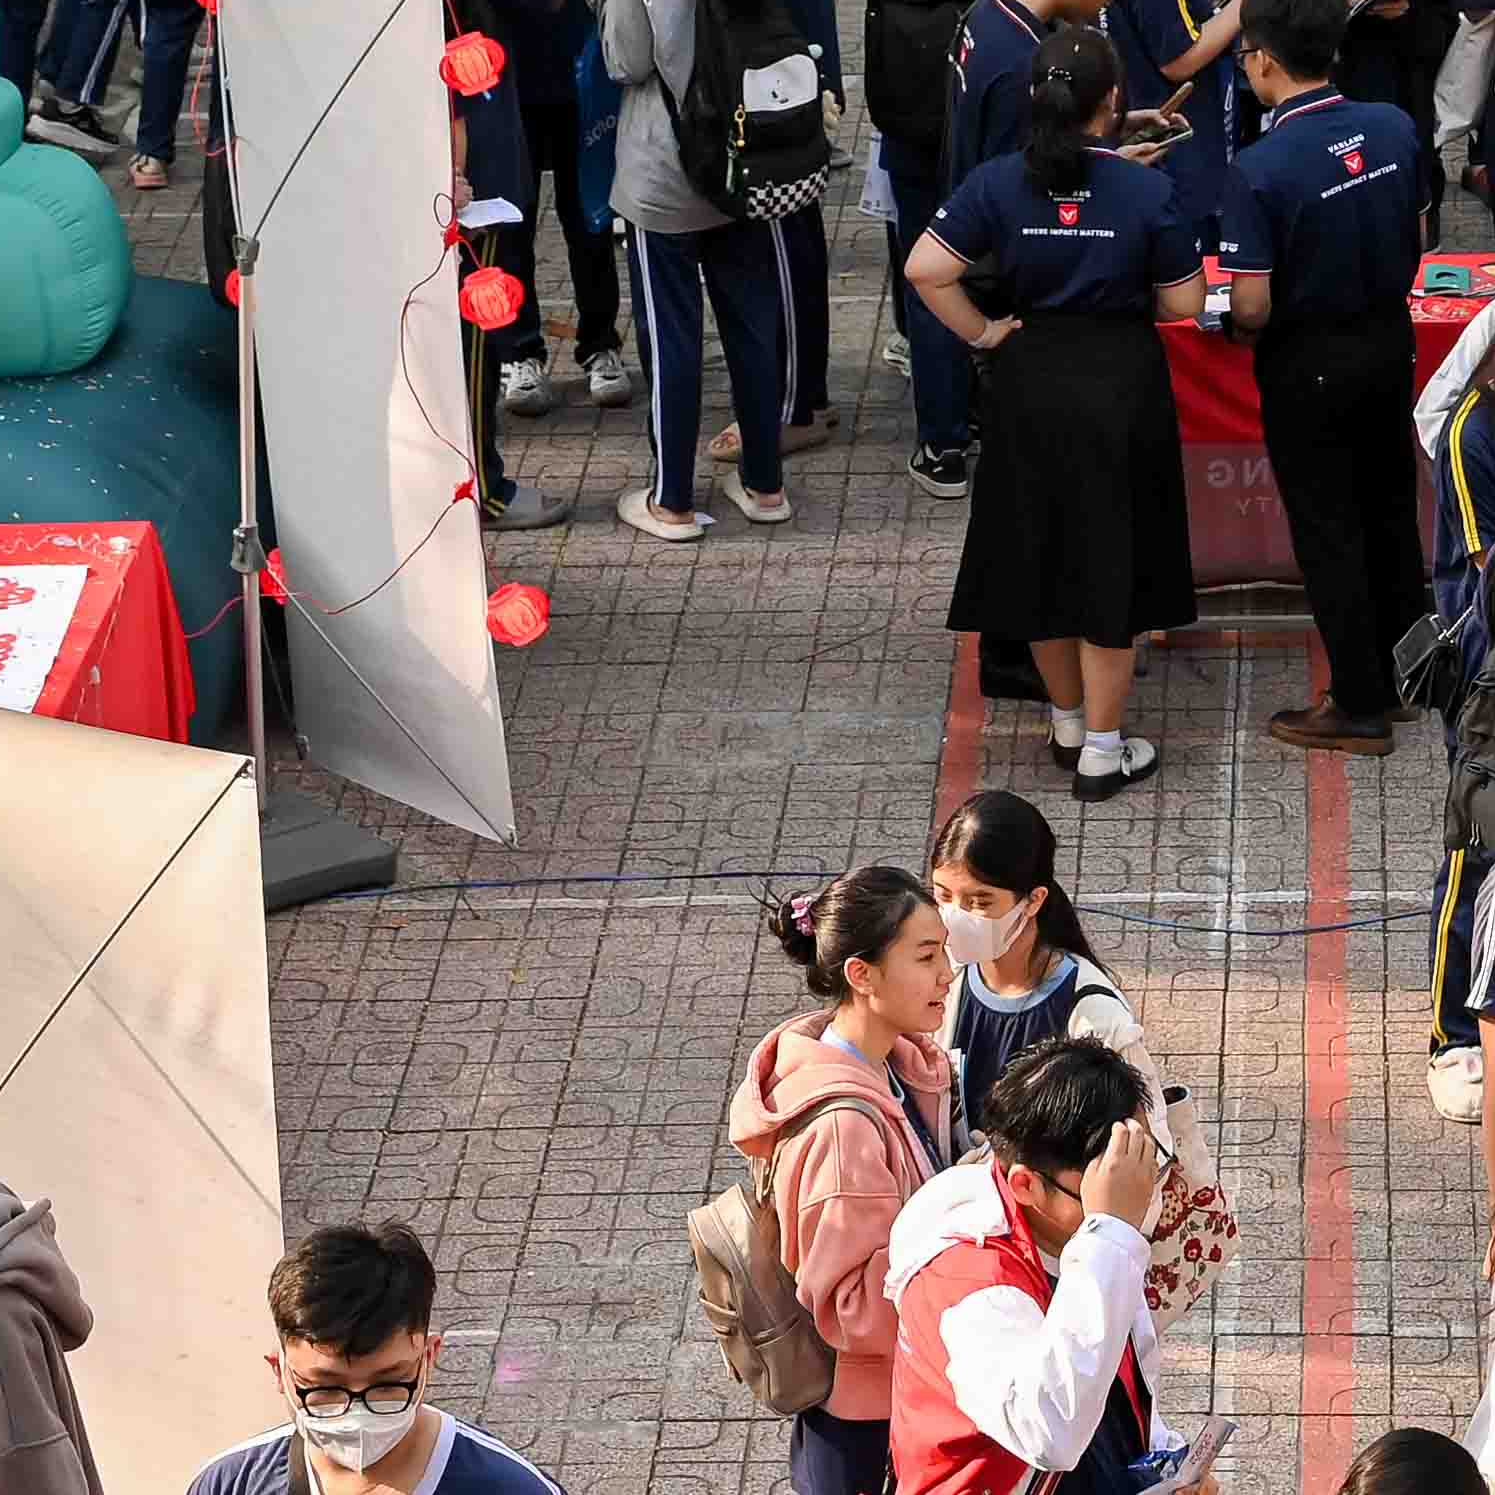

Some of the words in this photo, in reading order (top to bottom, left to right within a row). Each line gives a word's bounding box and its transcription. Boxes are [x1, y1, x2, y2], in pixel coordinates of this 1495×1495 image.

[1327, 133, 1365, 154] VANLANG
[1343, 174, 1367, 190] IMPACT
[1368, 163, 1397, 179] MATTERS
[1022, 227, 1048, 235] WHERE
[1049, 228, 1078, 236] IMPACT
[1079, 228, 1115, 238] MATTERS
